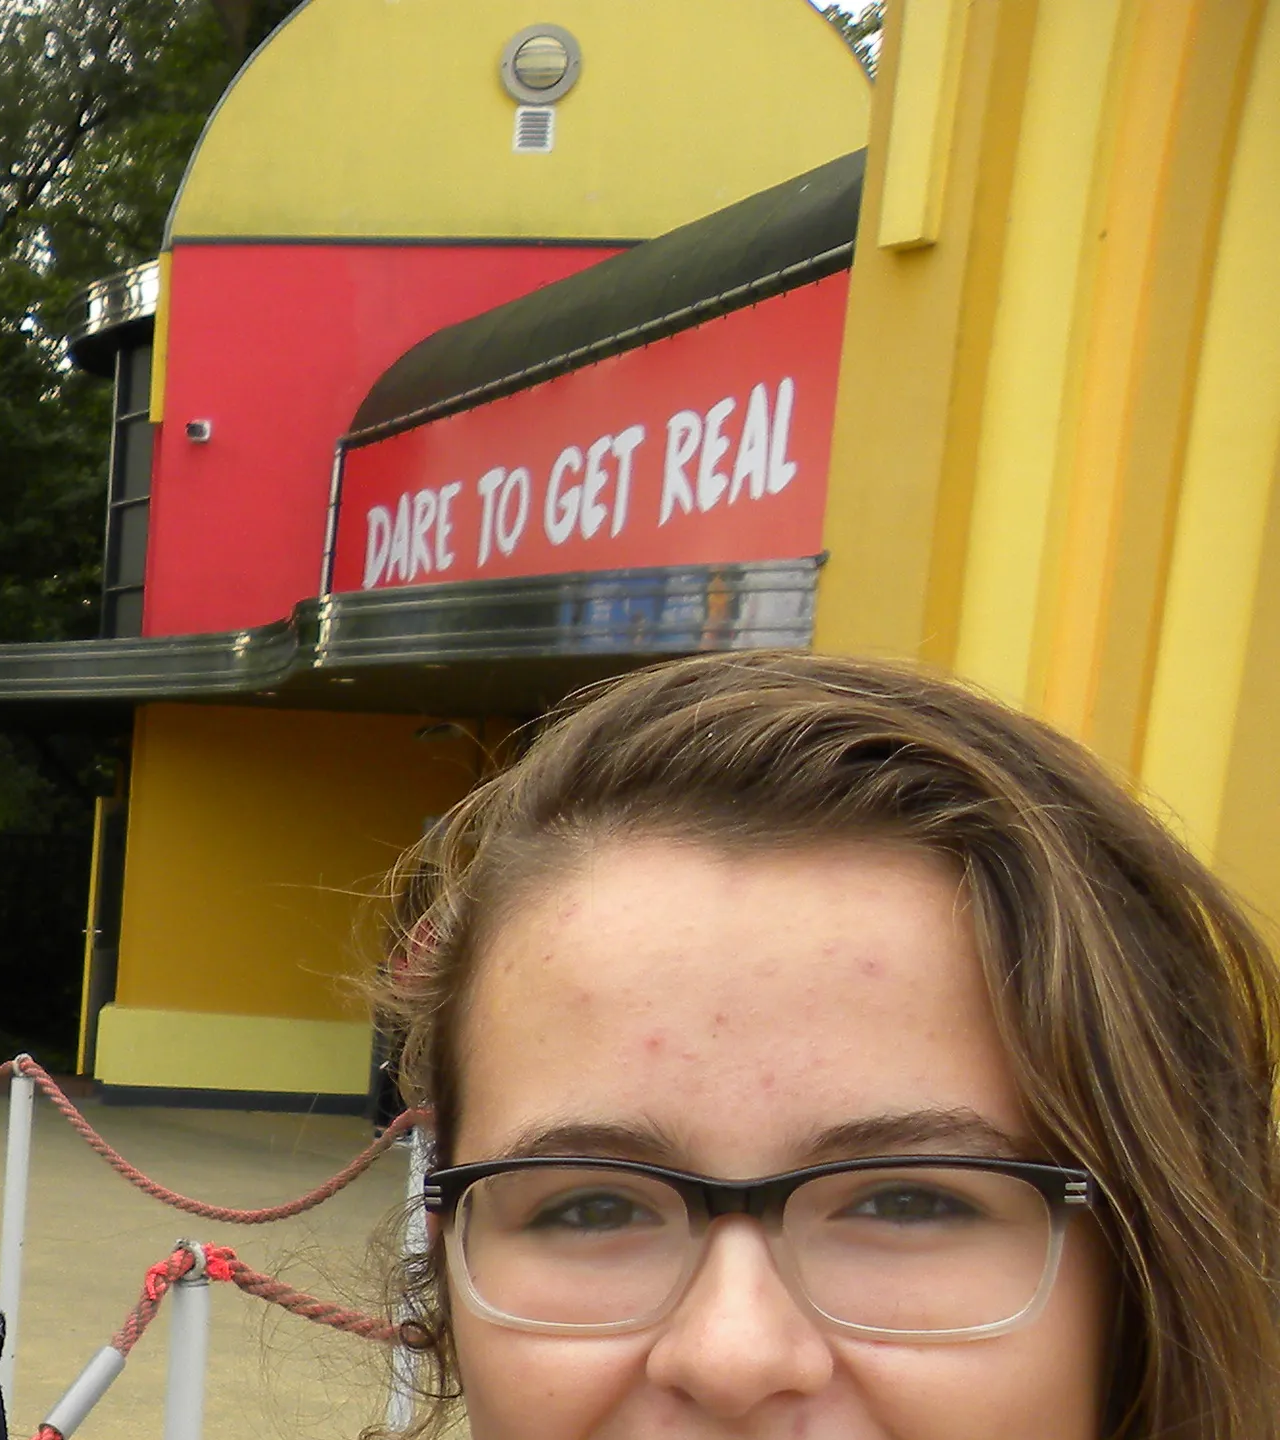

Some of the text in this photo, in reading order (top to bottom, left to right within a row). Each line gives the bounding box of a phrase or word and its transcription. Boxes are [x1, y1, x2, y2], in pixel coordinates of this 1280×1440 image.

[364, 377, 797, 590] DARE TO GET REAL
